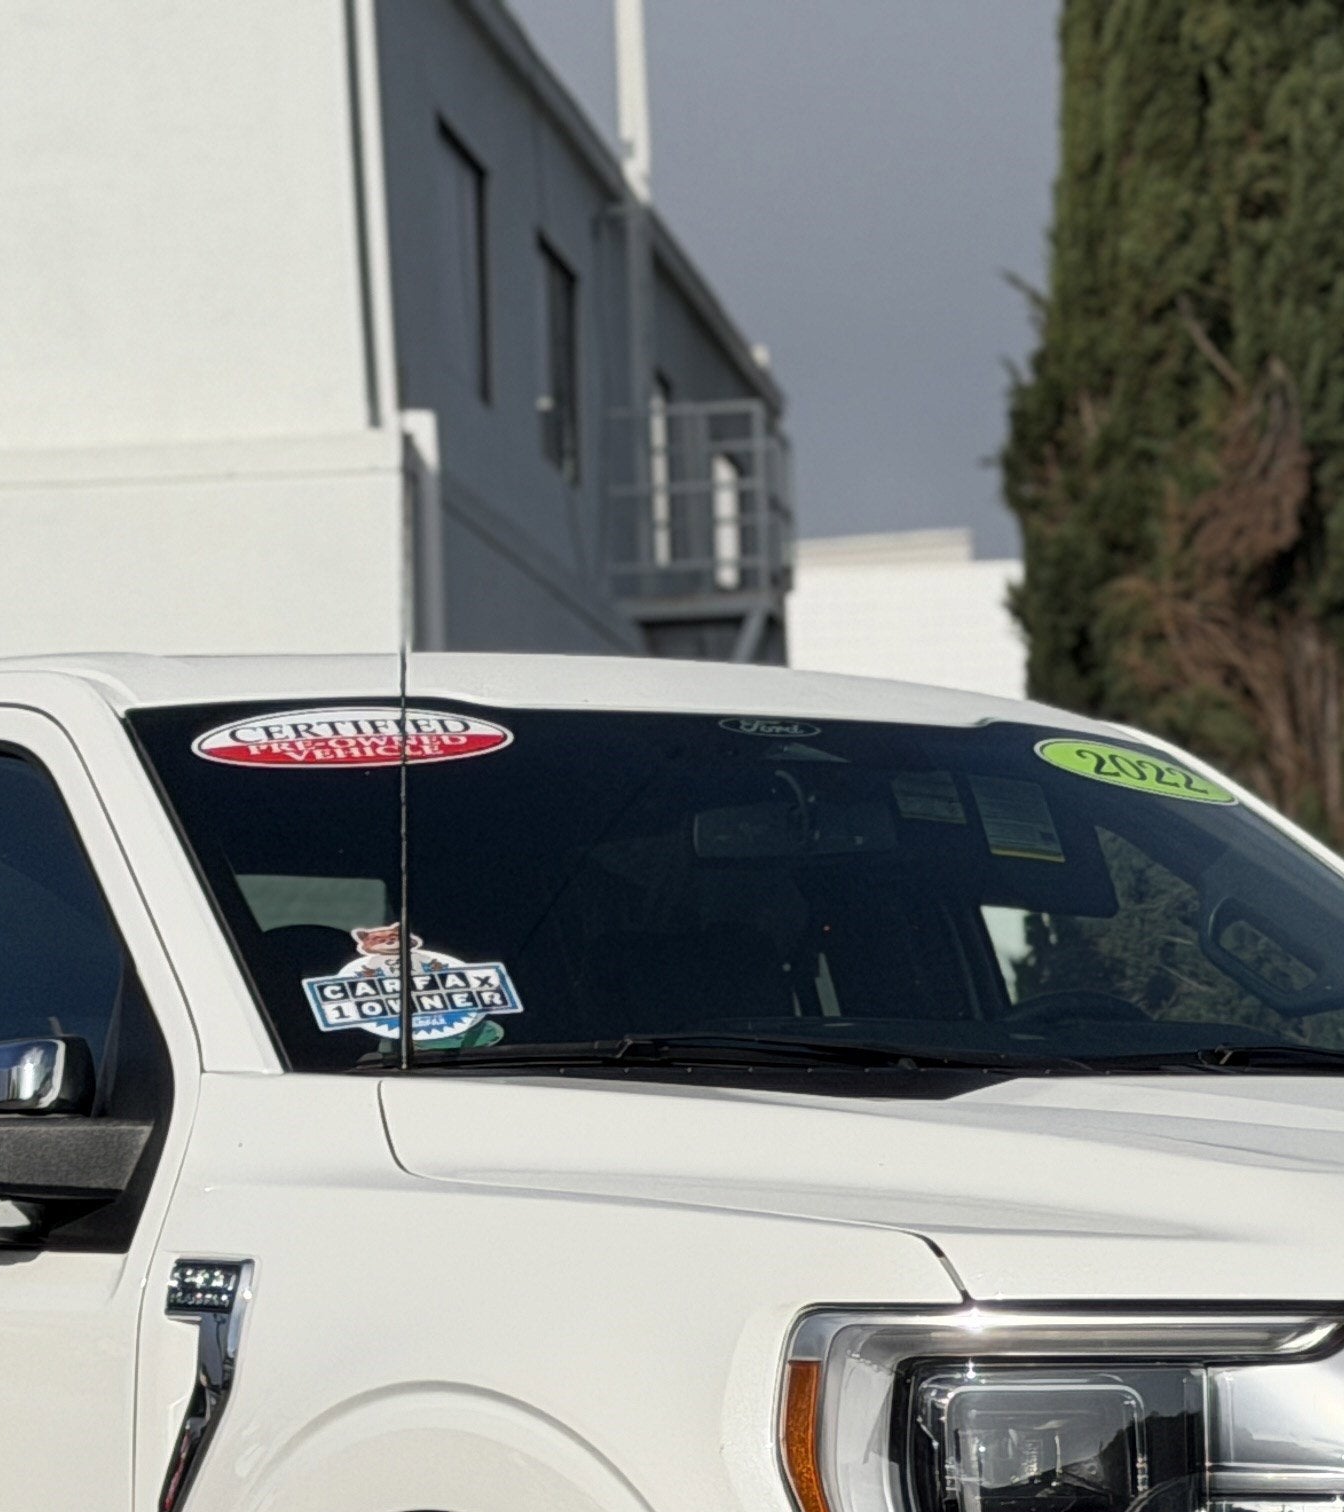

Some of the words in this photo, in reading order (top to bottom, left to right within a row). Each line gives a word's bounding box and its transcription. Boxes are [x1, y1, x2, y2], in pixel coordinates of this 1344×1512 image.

[229, 718, 471, 743] CERTIFIED
[285, 744, 443, 761] VEHICLE
[1075, 749, 1209, 795] 2022
[322, 974, 500, 1000] CARFAX
